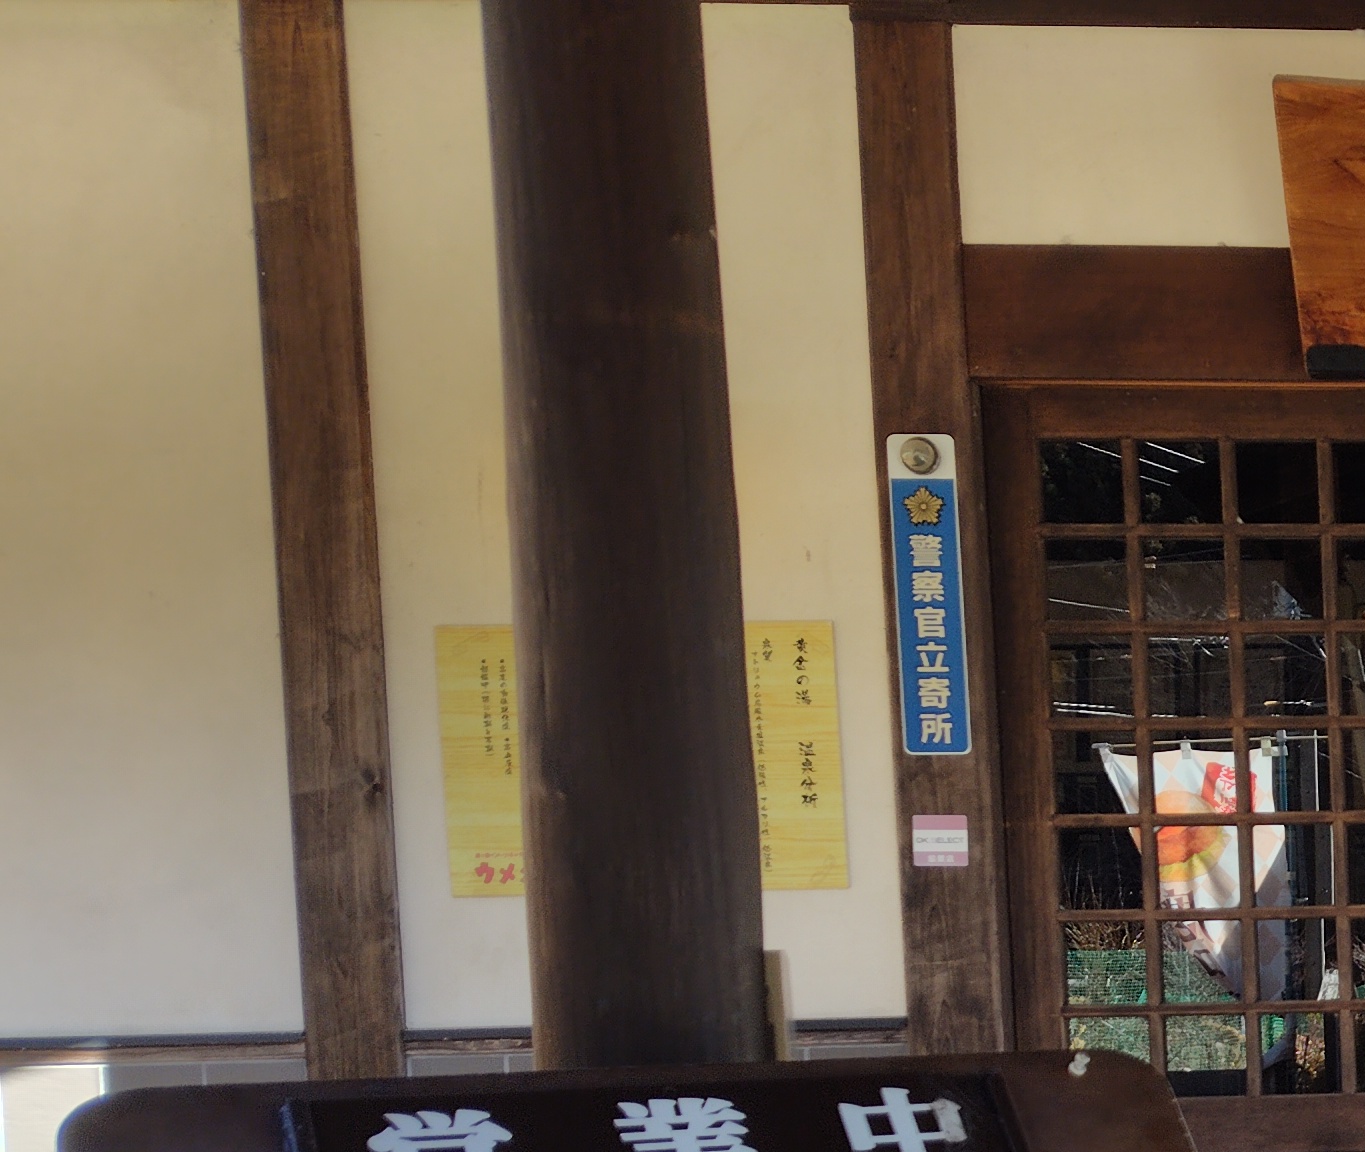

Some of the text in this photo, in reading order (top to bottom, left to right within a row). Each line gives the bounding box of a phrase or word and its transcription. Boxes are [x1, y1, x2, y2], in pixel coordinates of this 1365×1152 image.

[908, 534, 953, 745] 警察官立寄所
